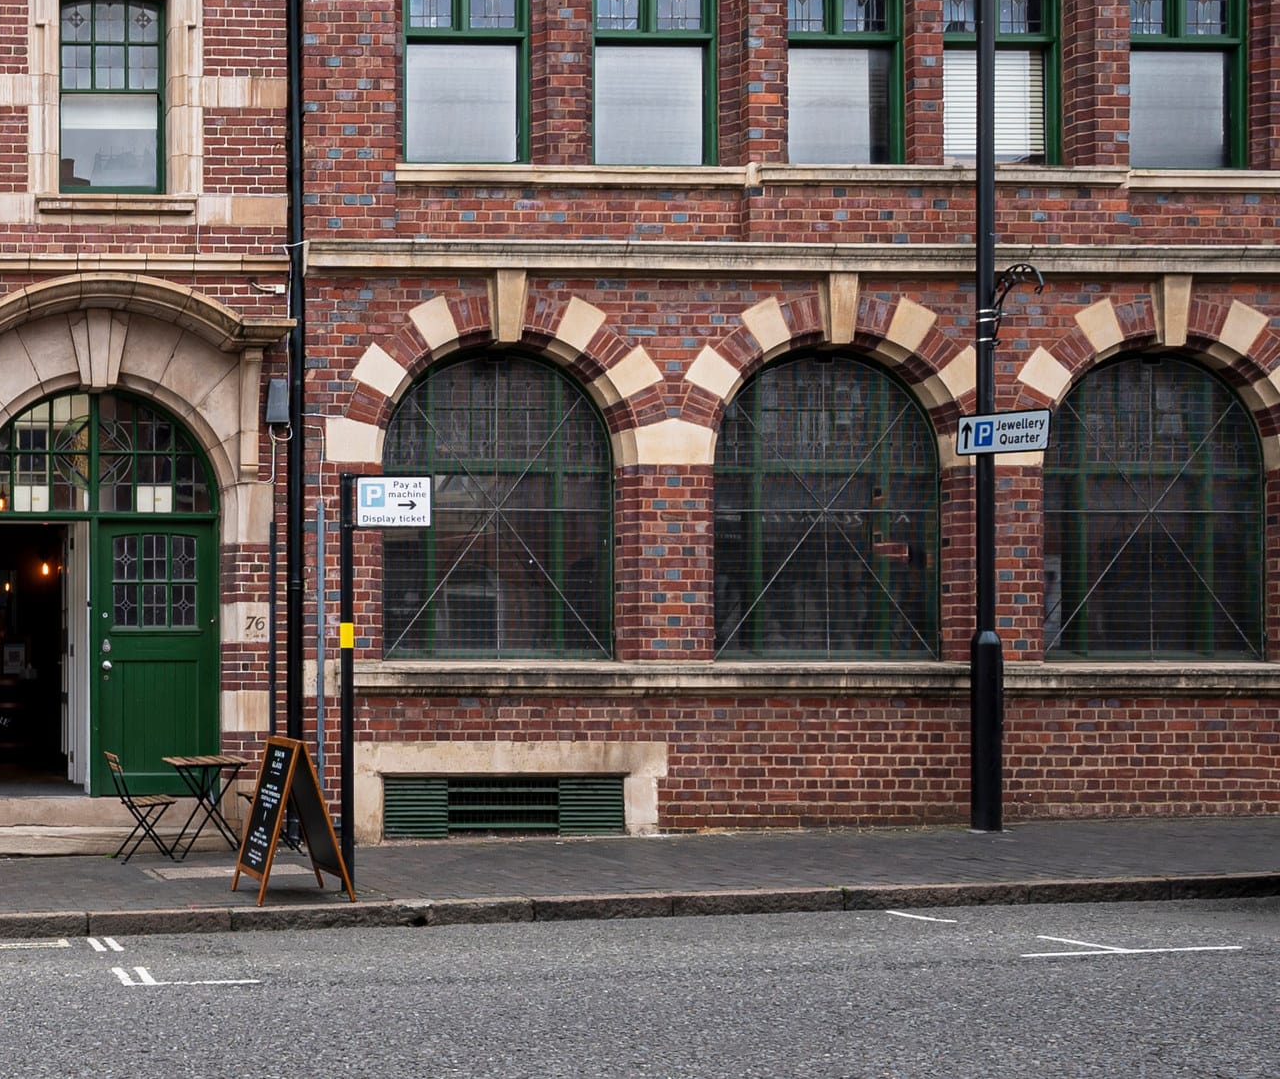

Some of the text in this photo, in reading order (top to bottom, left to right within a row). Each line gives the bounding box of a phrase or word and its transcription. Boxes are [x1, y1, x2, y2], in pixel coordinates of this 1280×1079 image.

[996, 418, 1045, 431] Jewellery
[1000, 432, 1040, 445] Quarter
[393, 481, 410, 489] Pay
[362, 515, 396, 523] Display
[245, 616, 267, 631] 76
